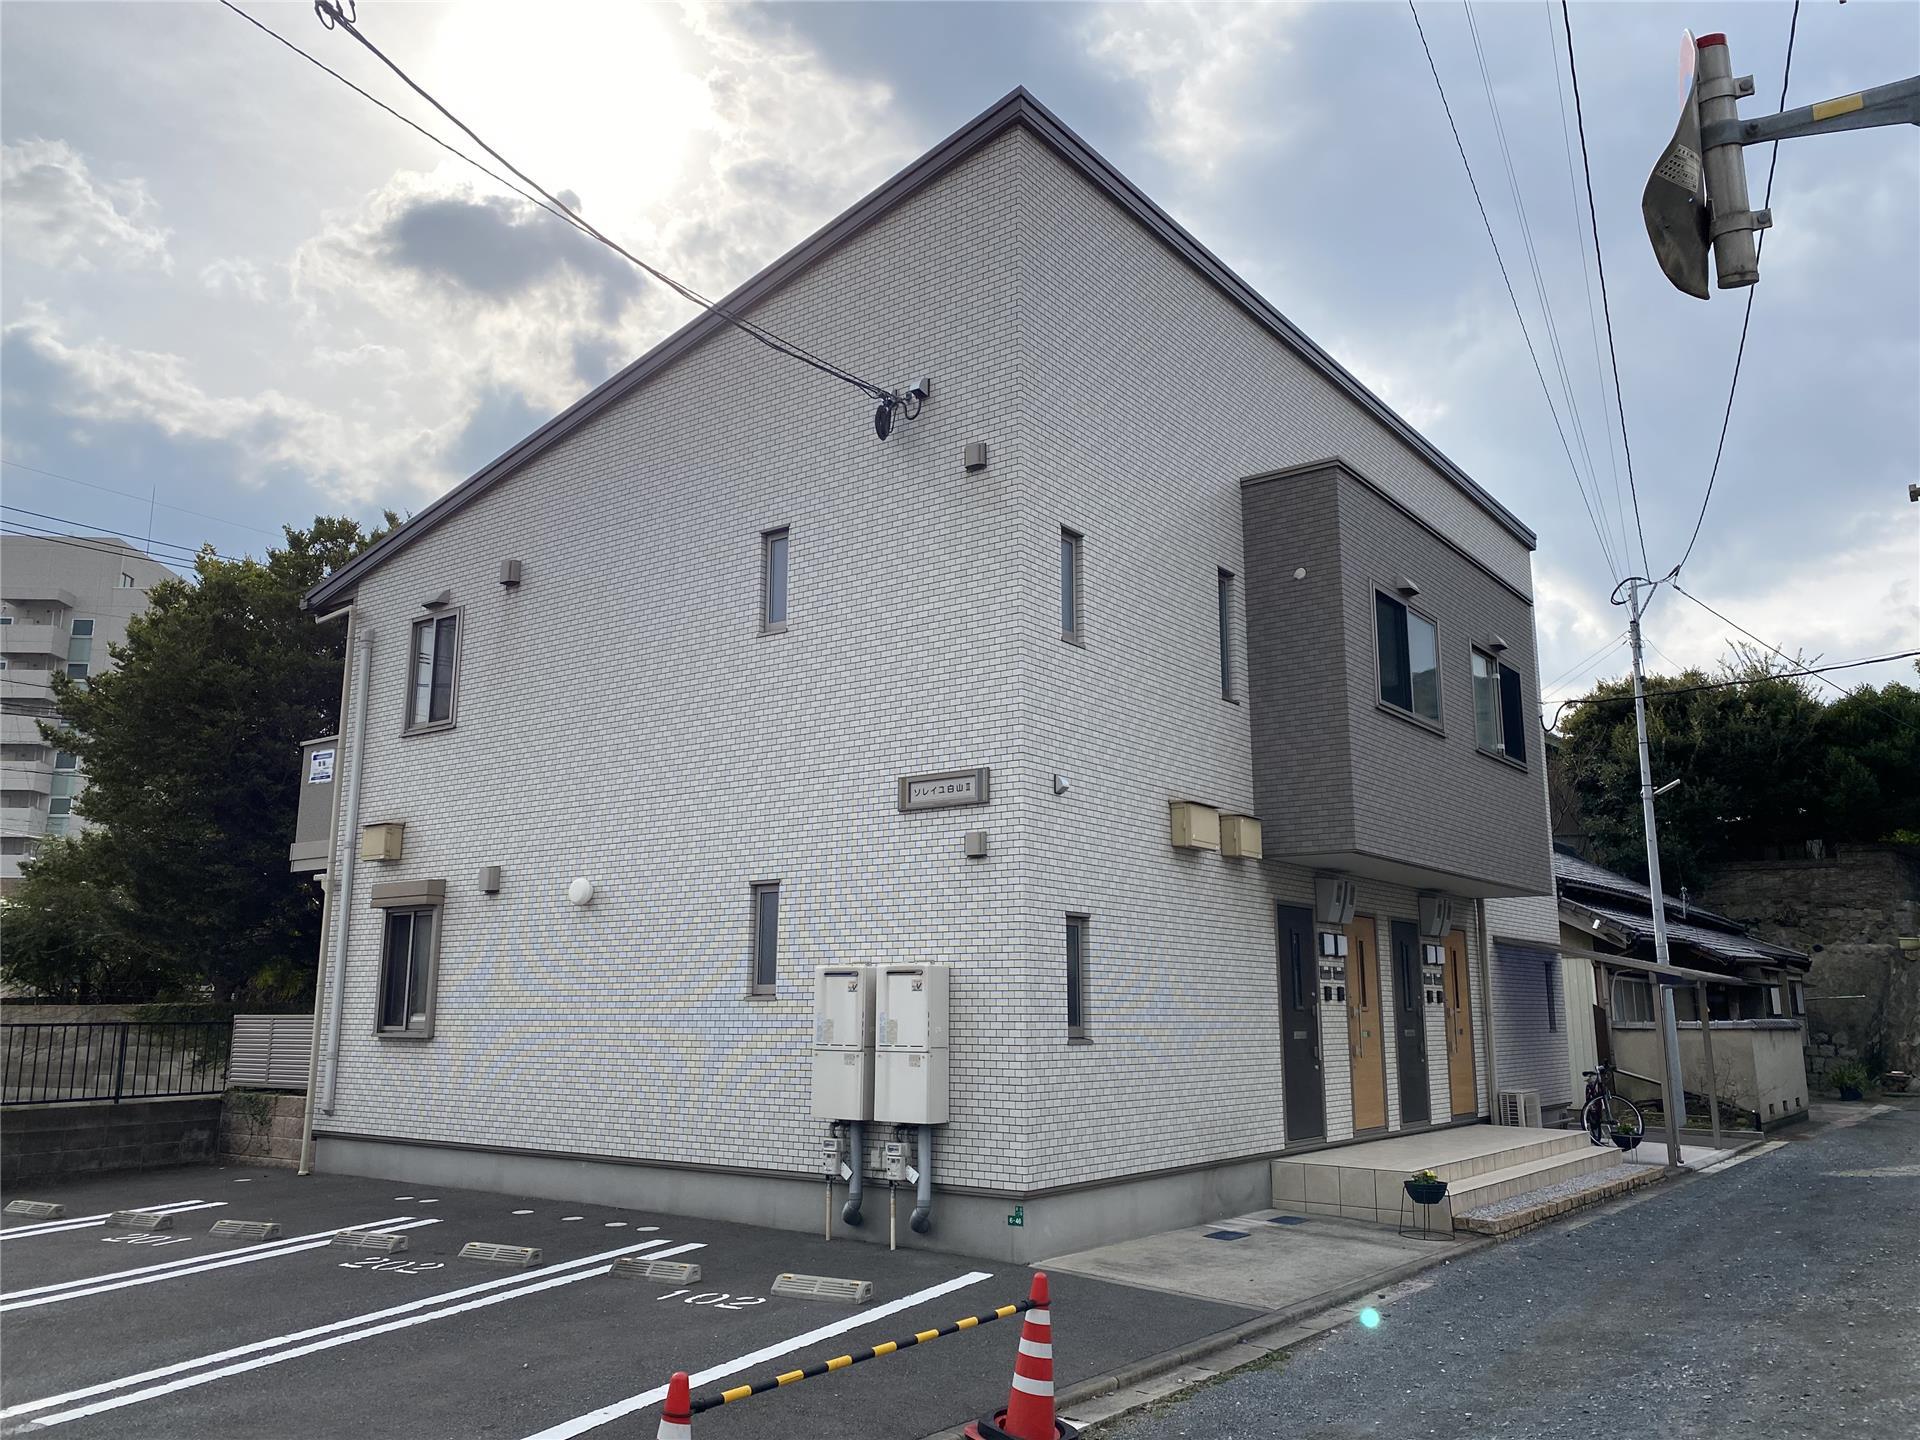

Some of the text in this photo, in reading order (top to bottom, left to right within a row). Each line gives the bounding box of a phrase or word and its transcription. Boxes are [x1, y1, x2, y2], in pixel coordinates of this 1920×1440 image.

[101, 1232, 193, 1247] 201
[338, 1256, 445, 1275] 202
[656, 1289, 767, 1310] 102
